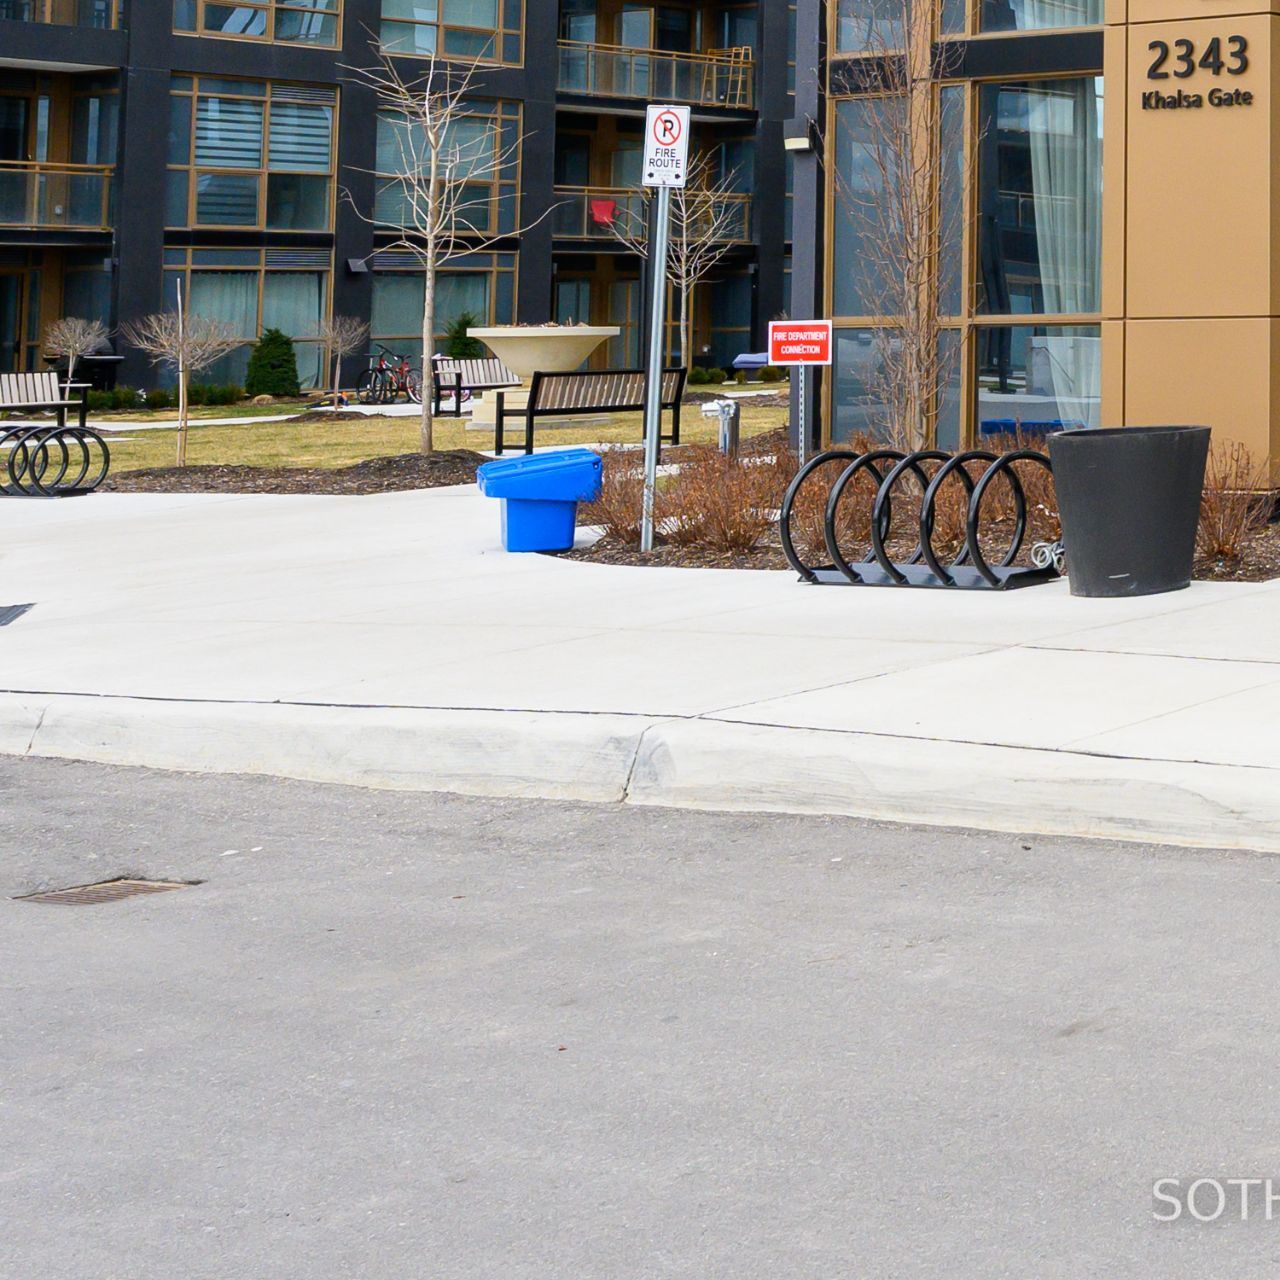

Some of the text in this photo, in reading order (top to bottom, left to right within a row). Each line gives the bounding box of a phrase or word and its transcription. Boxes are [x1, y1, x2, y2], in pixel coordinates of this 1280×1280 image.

[1147, 35, 1249, 79] 2343
[1141, 87, 1253, 110] Khalsa Gate
[655, 148, 676, 158] FIRE
[649, 158, 681, 168] ROUTE
[773, 331, 828, 341] FIRE DEPARTMENT
[780, 345, 821, 354] CONNECTION
